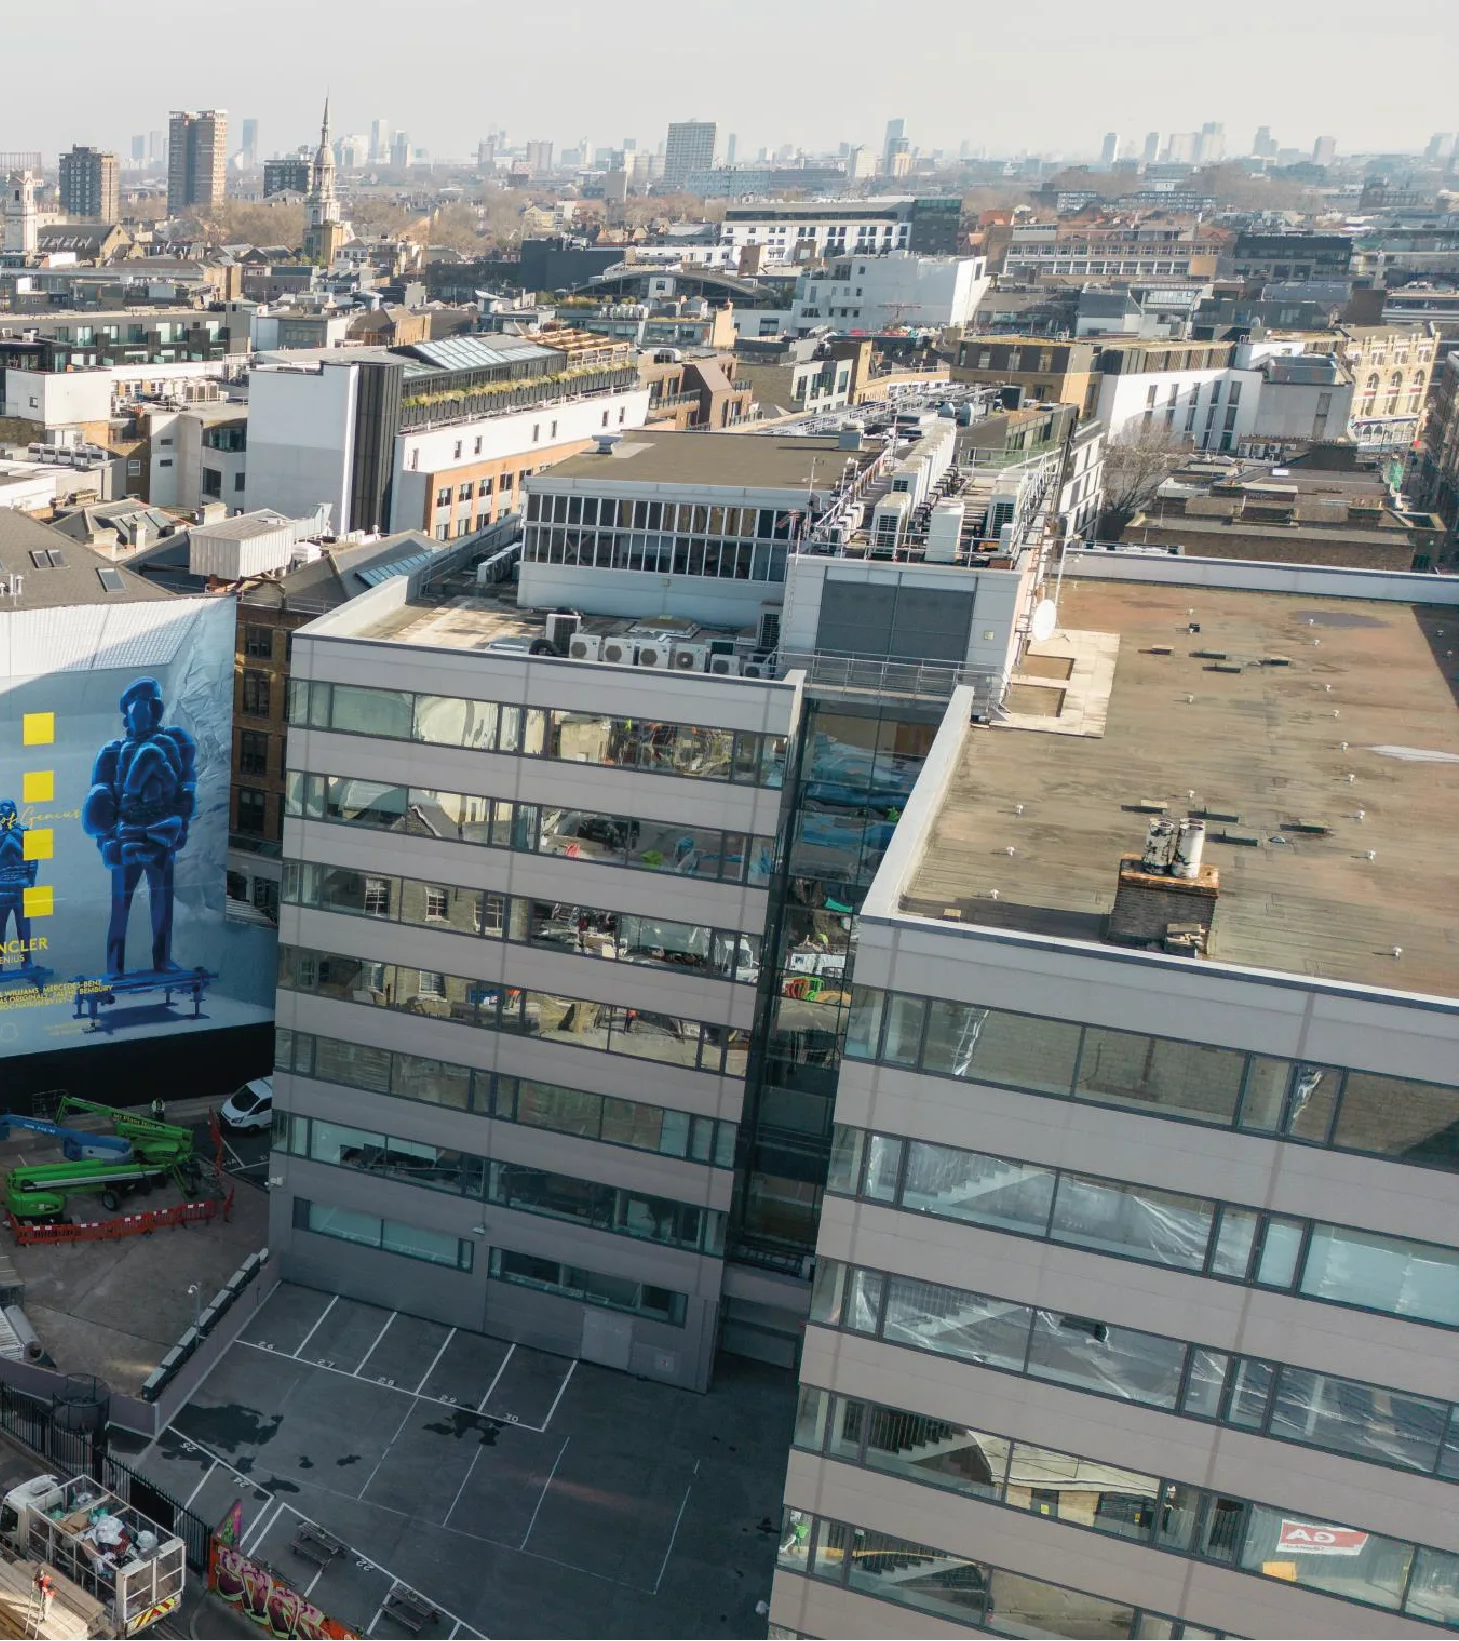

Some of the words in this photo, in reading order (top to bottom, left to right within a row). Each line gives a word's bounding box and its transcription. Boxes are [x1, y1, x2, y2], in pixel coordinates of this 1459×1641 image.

[1, 812, 17, 830] of
[20, 805, 80, 829] Genius
[4, 988, 39, 997] WILLIAMS
[356, 1558, 376, 1571] 22
